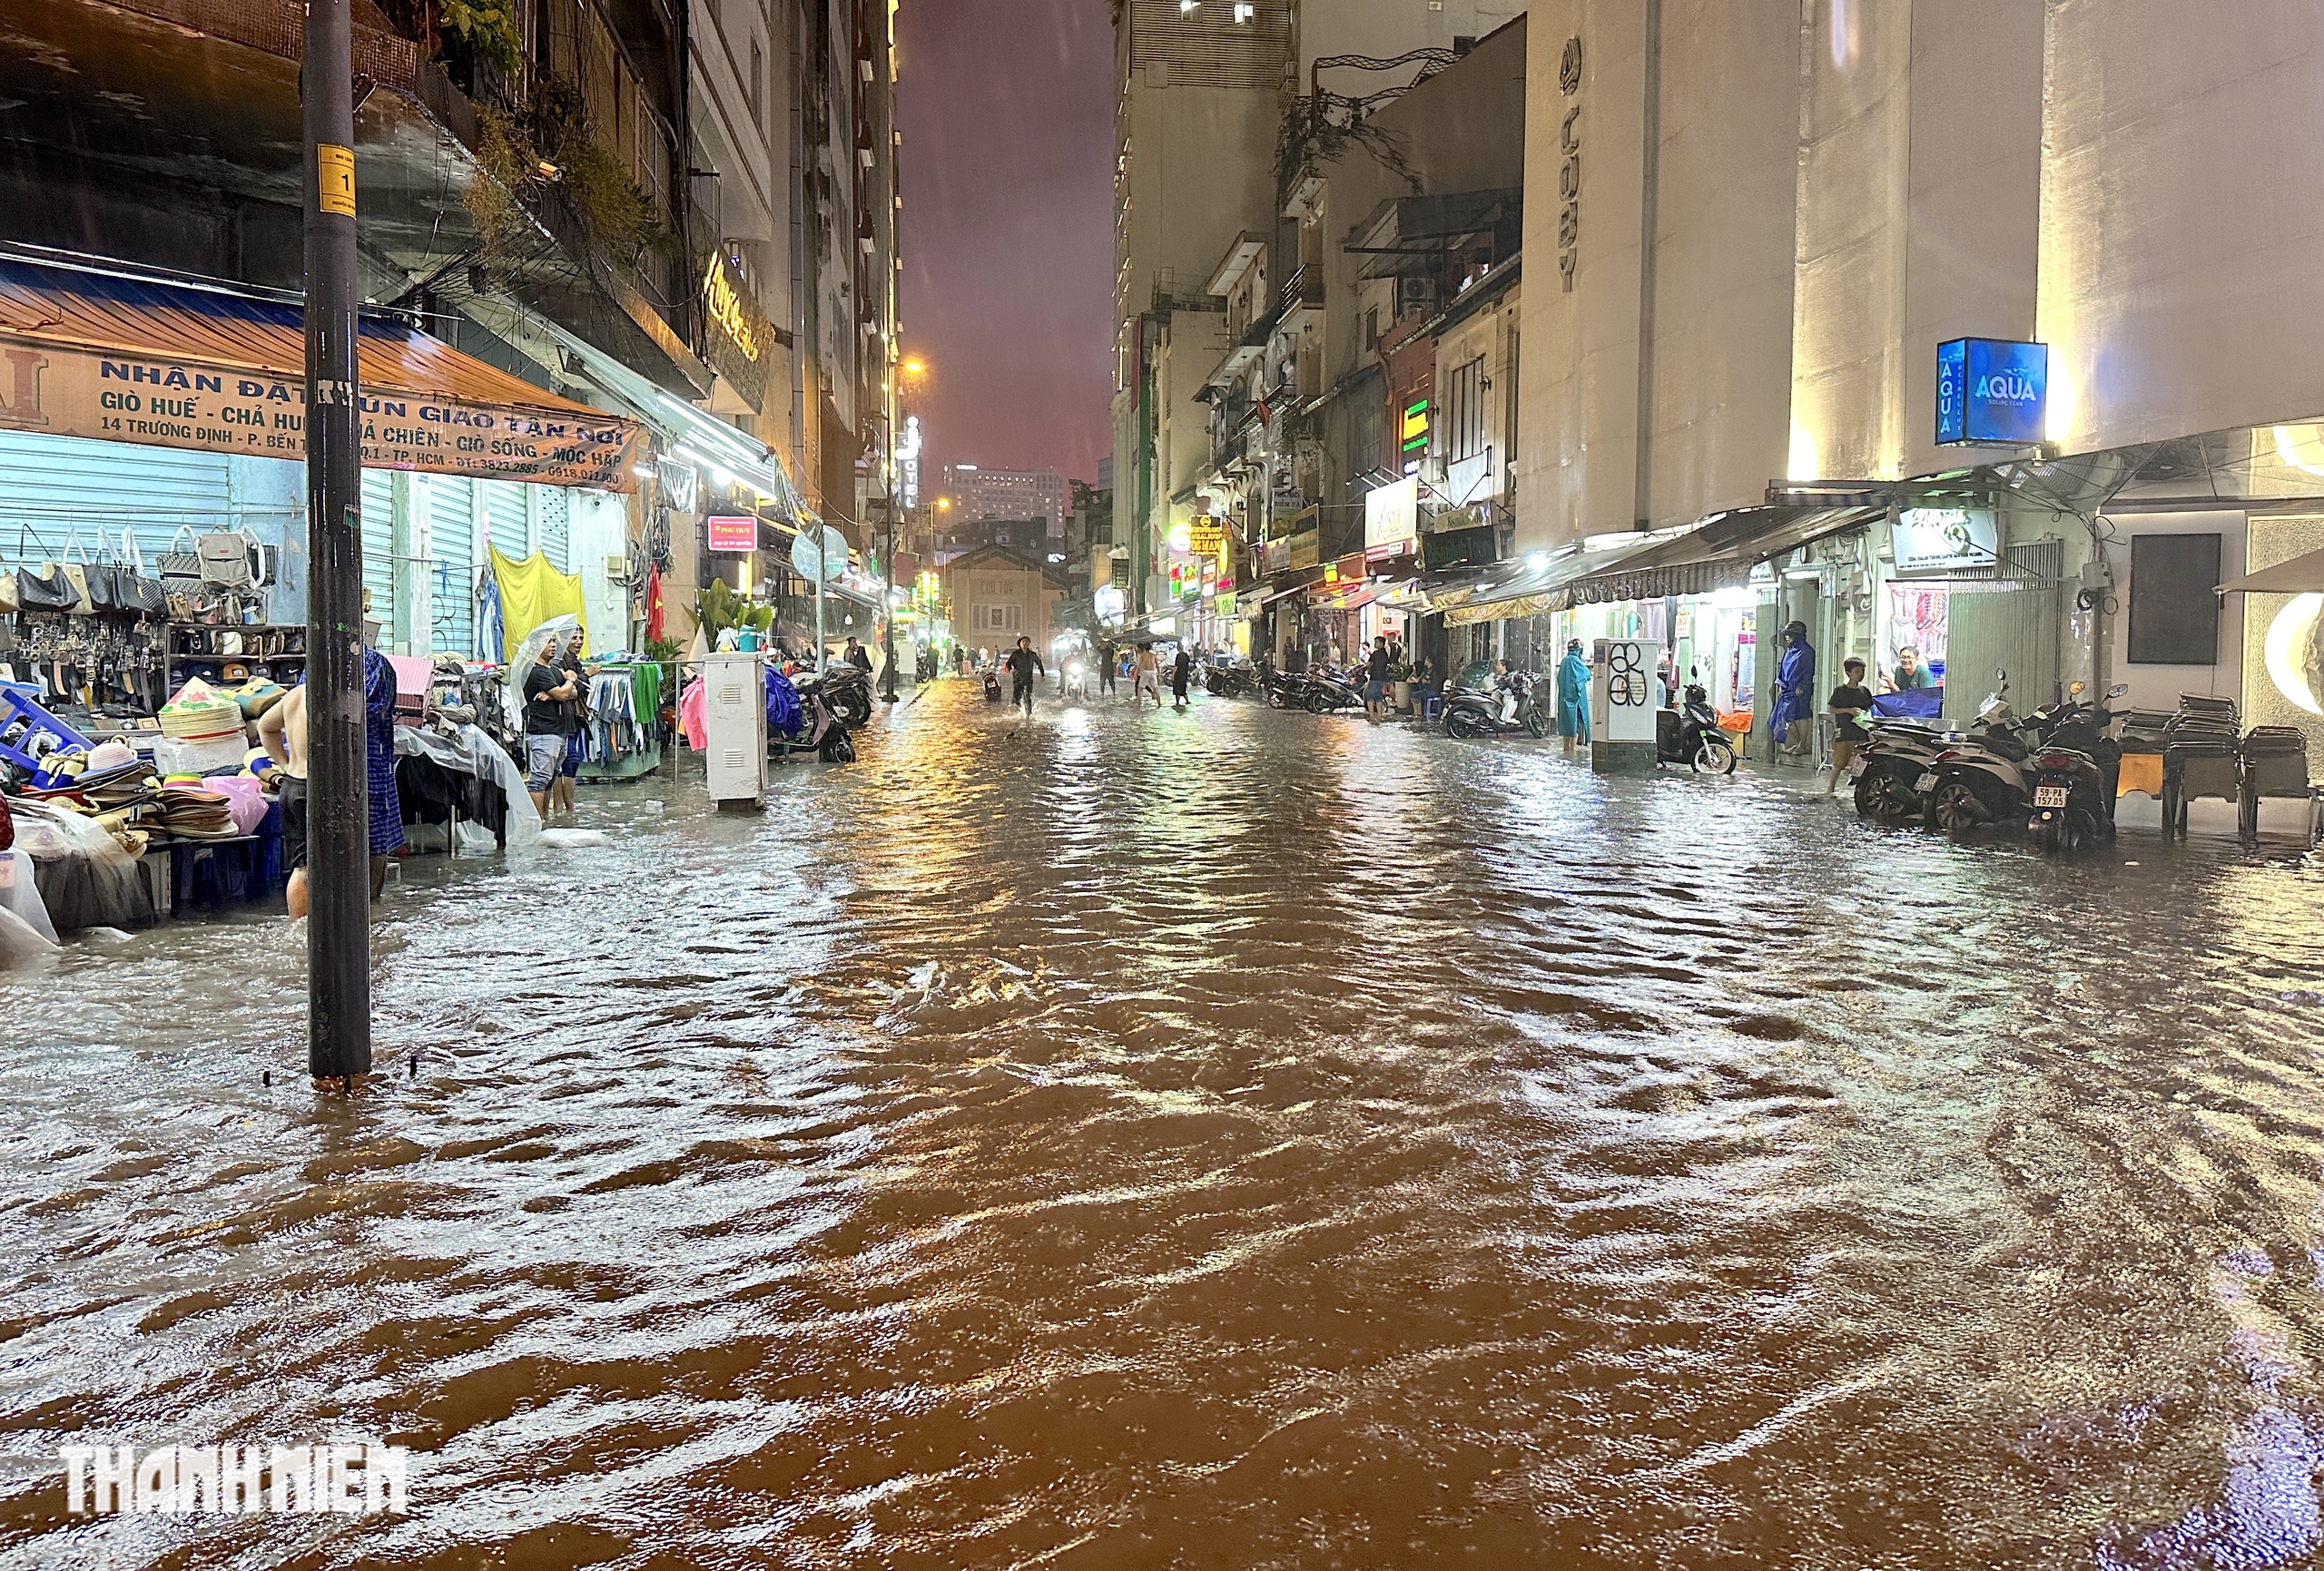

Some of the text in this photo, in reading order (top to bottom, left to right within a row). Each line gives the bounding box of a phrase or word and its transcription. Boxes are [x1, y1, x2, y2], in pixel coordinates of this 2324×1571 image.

[341, 173, 350, 191] 1
[101, 360, 222, 392] NHẬN
[419, 406, 494, 428] GIAO
[504, 417, 566, 438] TẬN
[576, 427, 623, 446] NƠI
[1940, 362, 1953, 434] AQUA
[1975, 375, 2036, 400] AQUA
[101, 390, 141, 412] GIÒ
[151, 396, 201, 419] HUẾ
[222, 404, 265, 427] CHẢ
[274, 412, 306, 431] HU
[102, 417, 121, 431] 14
[126, 419, 192, 439] TRƯƠNG
[196, 427, 232, 444] ĐỊNH
[248, 433, 261, 447] P.
[266, 432, 296, 450] BẾN
[383, 427, 439, 447] CHIÊN
[457, 434, 485, 453] GIÒ
[491, 437, 537, 458] SỐNG
[553, 446, 586, 466] MỘC
[592, 449, 622, 467] HẤP
[393, 449, 412, 463] TP.
[417, 452, 445, 466] HCM
[480, 458, 539, 475] 3823.2885
